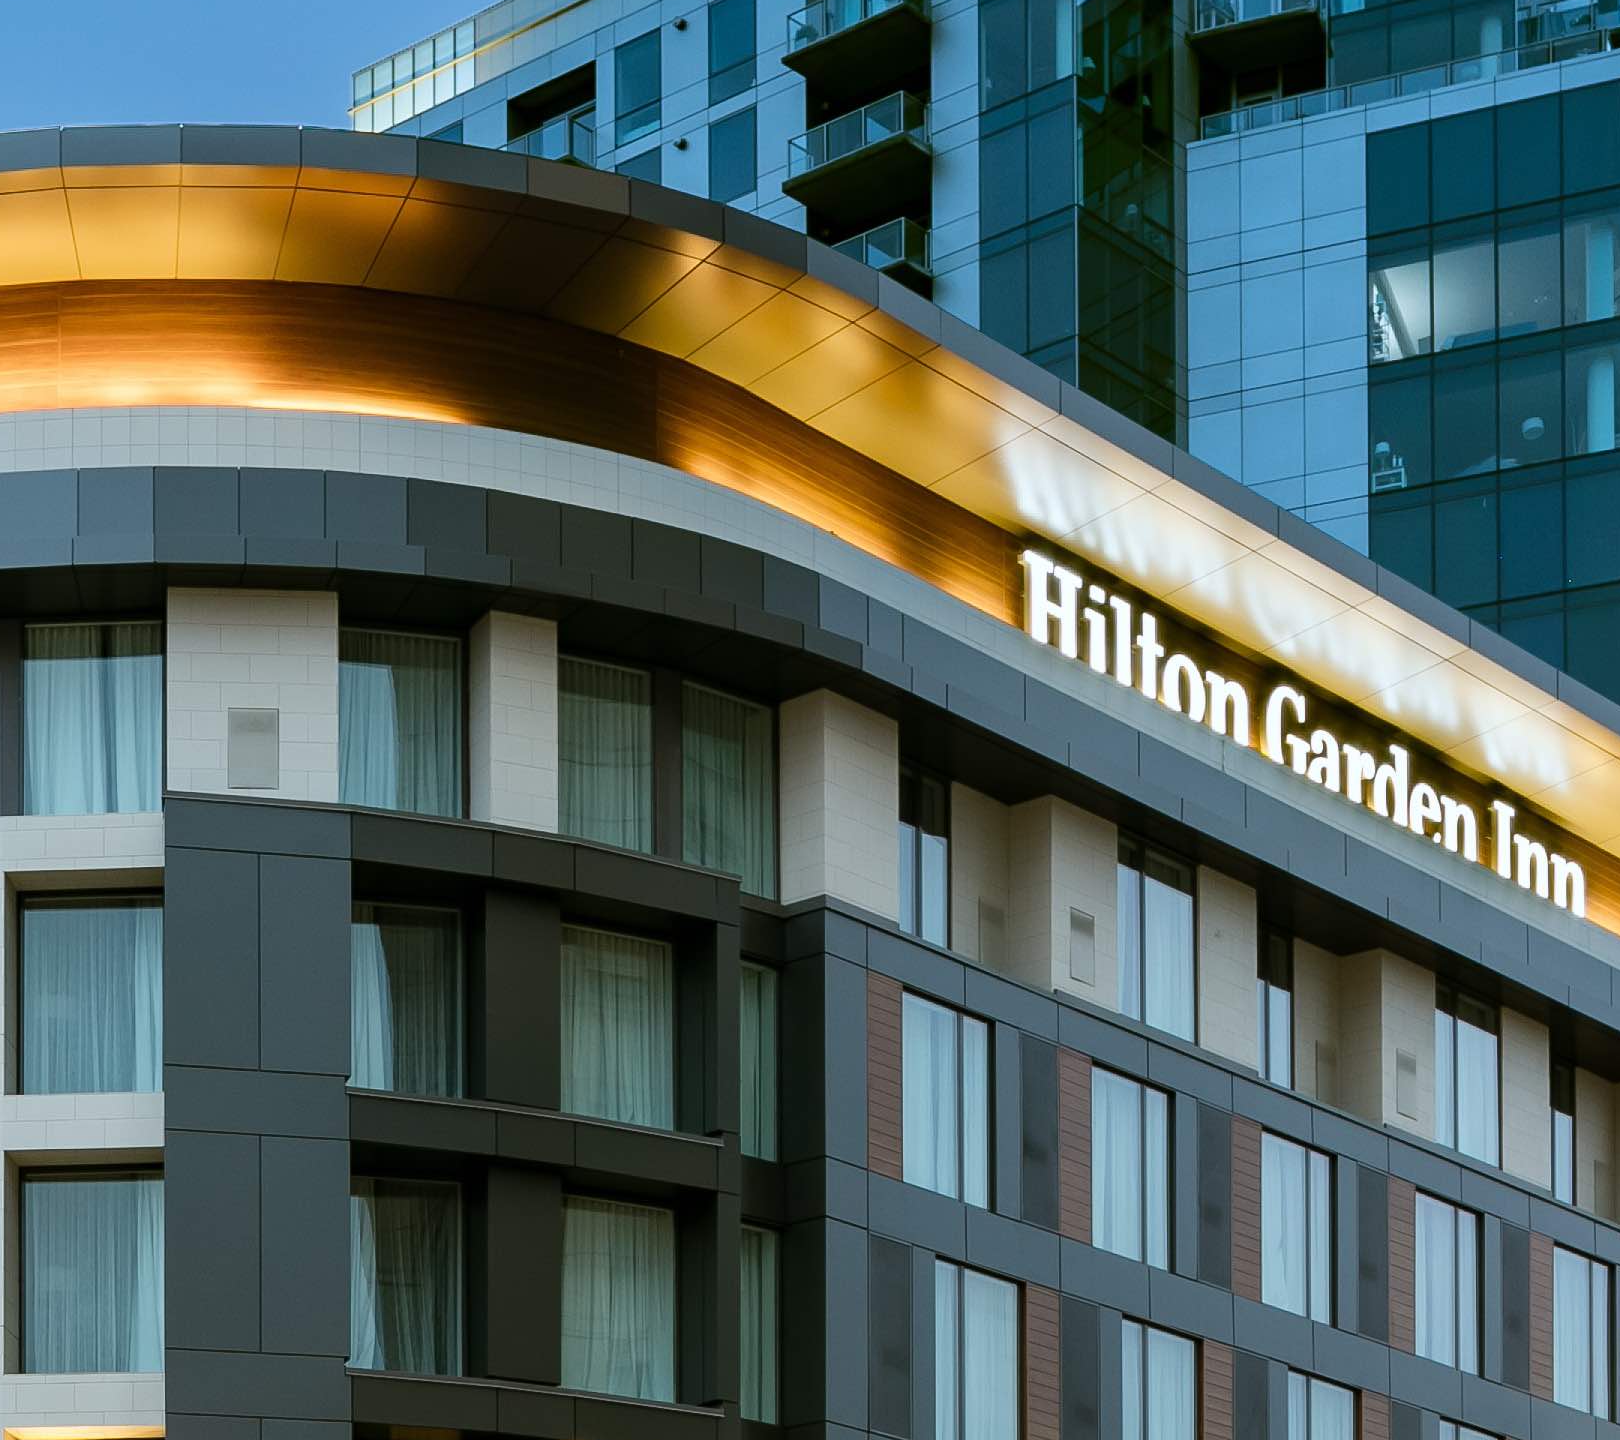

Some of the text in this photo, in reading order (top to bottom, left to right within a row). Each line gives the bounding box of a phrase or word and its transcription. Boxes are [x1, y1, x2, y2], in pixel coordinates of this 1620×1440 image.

[1021, 548, 1586, 918] Hilton Garden Inn
